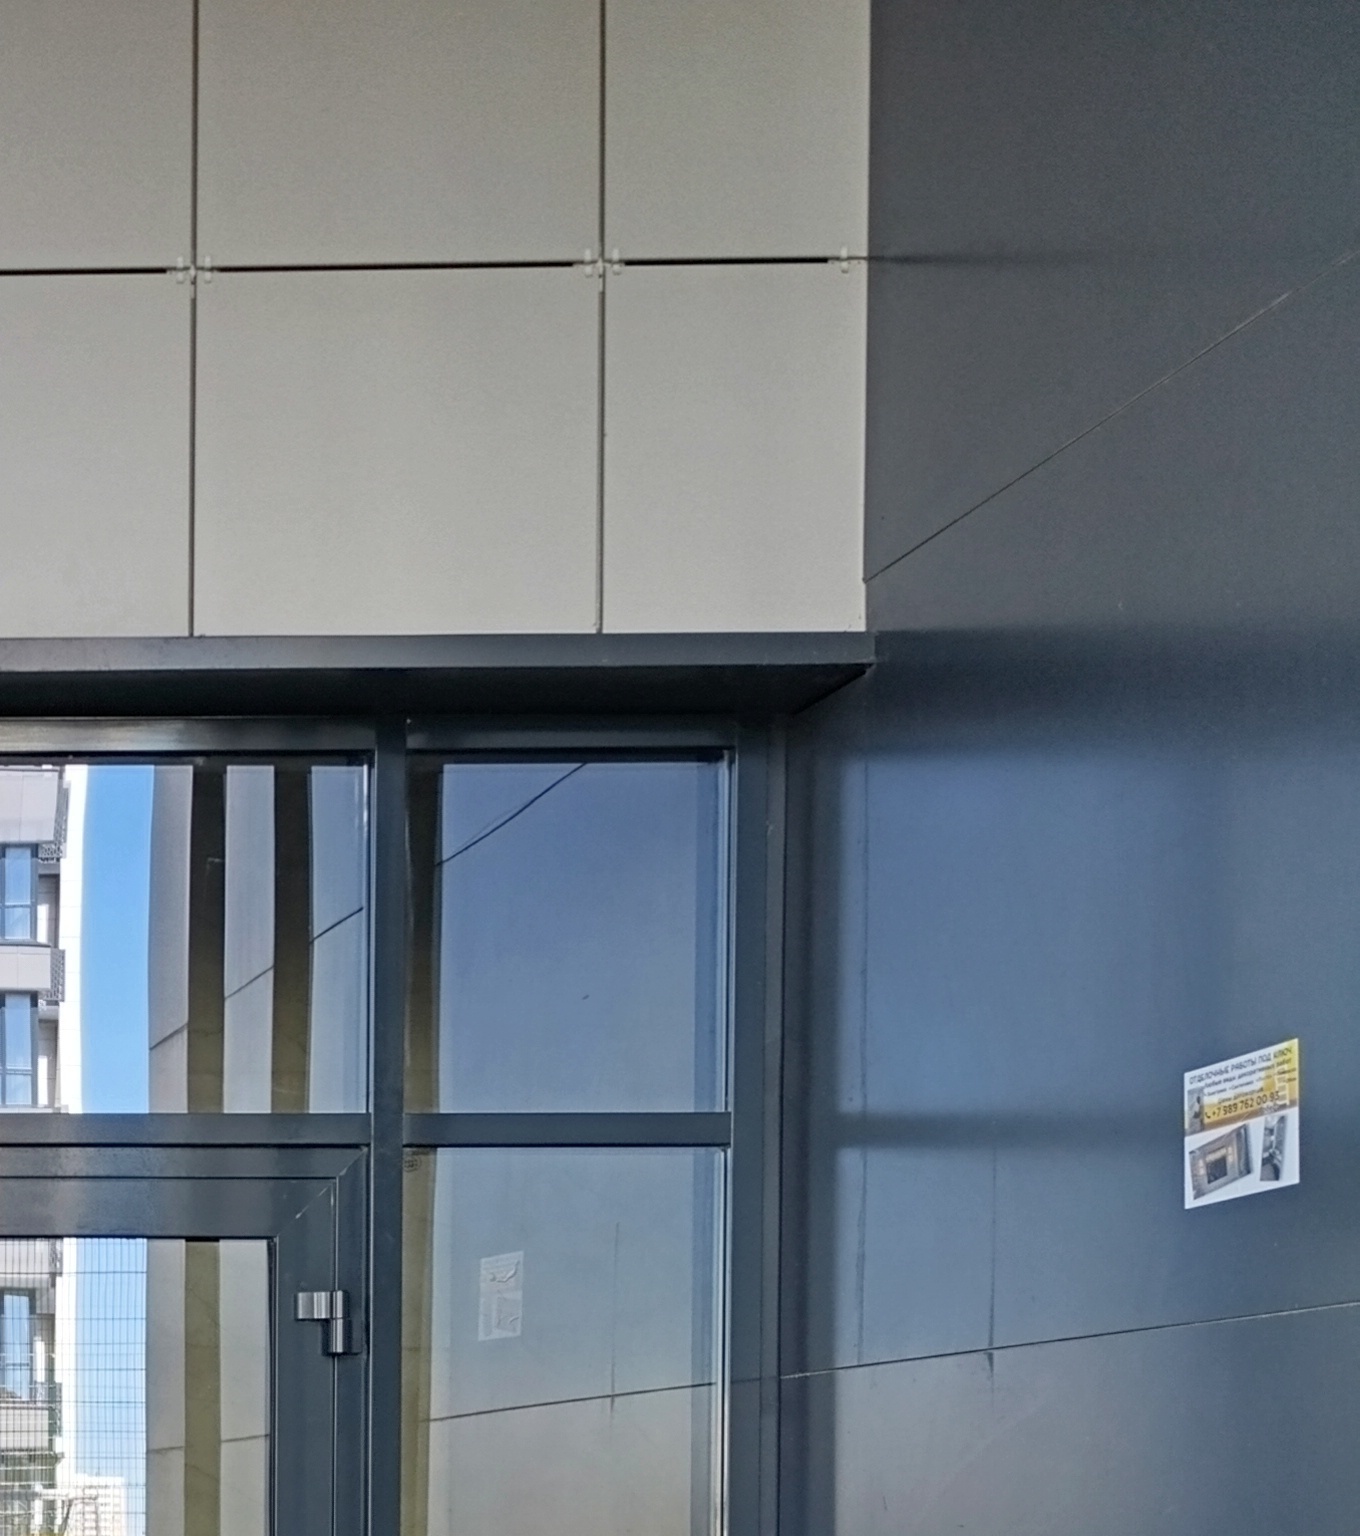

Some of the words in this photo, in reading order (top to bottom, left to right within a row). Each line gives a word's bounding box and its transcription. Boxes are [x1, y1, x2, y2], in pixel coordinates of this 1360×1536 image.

[1230, 1057, 1256, 1071] РАБОТЫ
[1258, 1053, 1271, 1062] ПОД
[1212, 1107, 1221, 1118] +7
[1240, 1097, 1254, 1110] 762
[1257, 1094, 1267, 1106] 00
